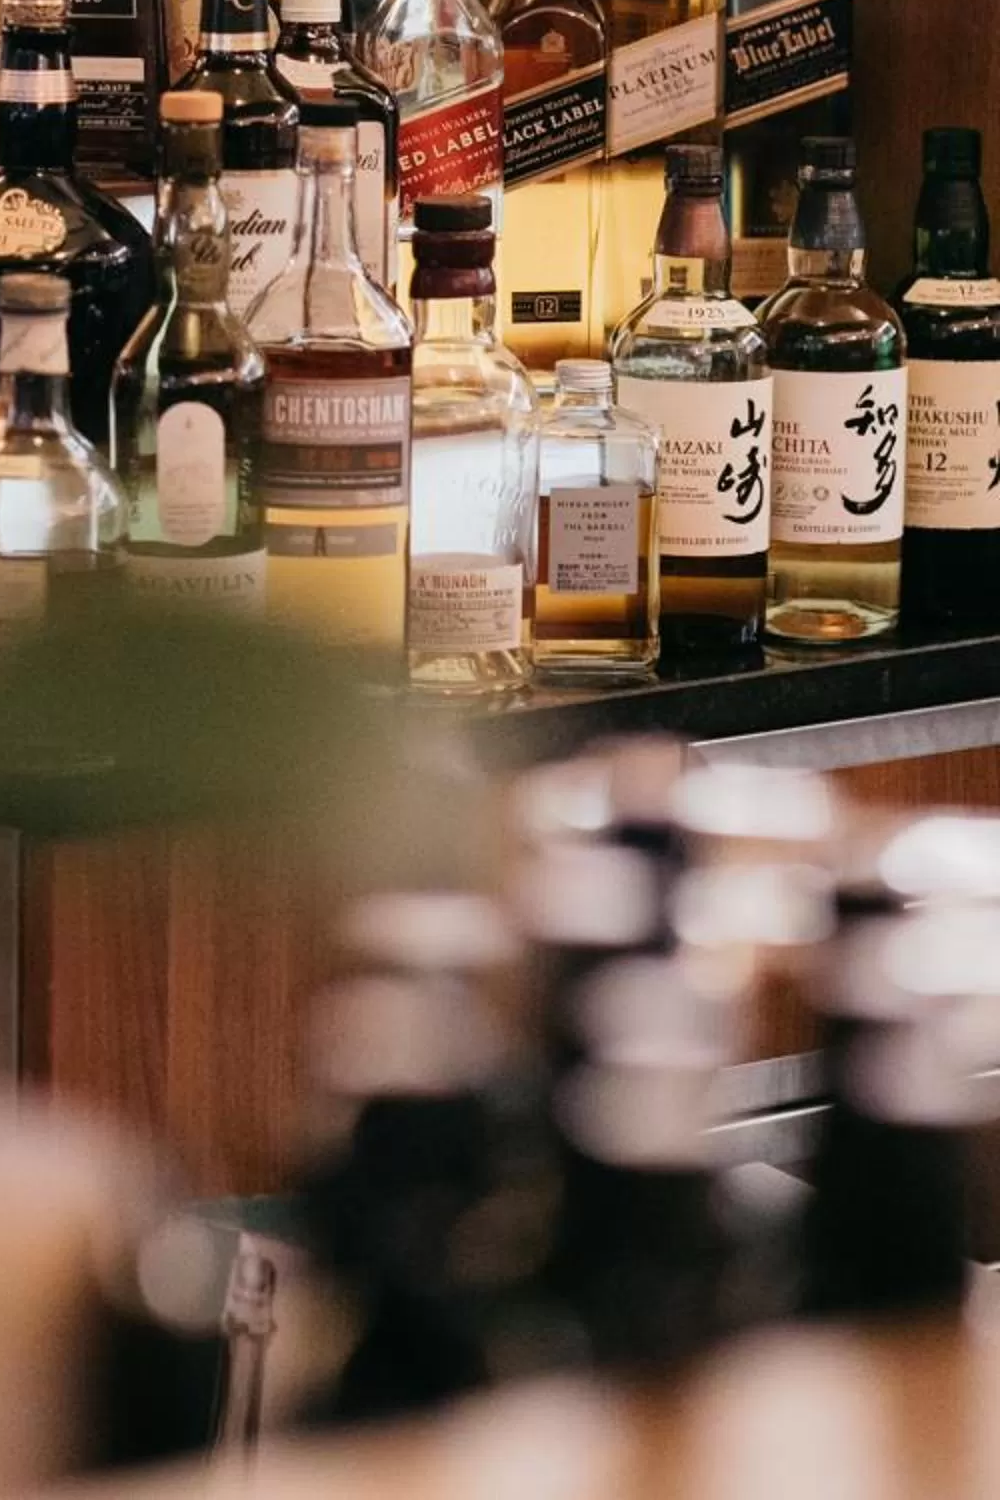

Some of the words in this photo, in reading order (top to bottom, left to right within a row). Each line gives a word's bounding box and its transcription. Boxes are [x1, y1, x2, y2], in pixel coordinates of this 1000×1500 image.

[731, 43, 782, 76] Blue
[778, 15, 837, 57] Label
[609, 49, 717, 100] PLATINUM
[502, 119, 547, 148] LACK
[550, 98, 605, 128] LABEL
[398, 149, 428, 172] ED
[433, 121, 500, 157] LABEL
[399, 128, 441, 151] OHNNIE
[909, 395, 937, 408] THE
[907, 407, 988, 426] HAKUSHU
[772, 436, 831, 455] CHITA
[924, 451, 948, 473] 12
